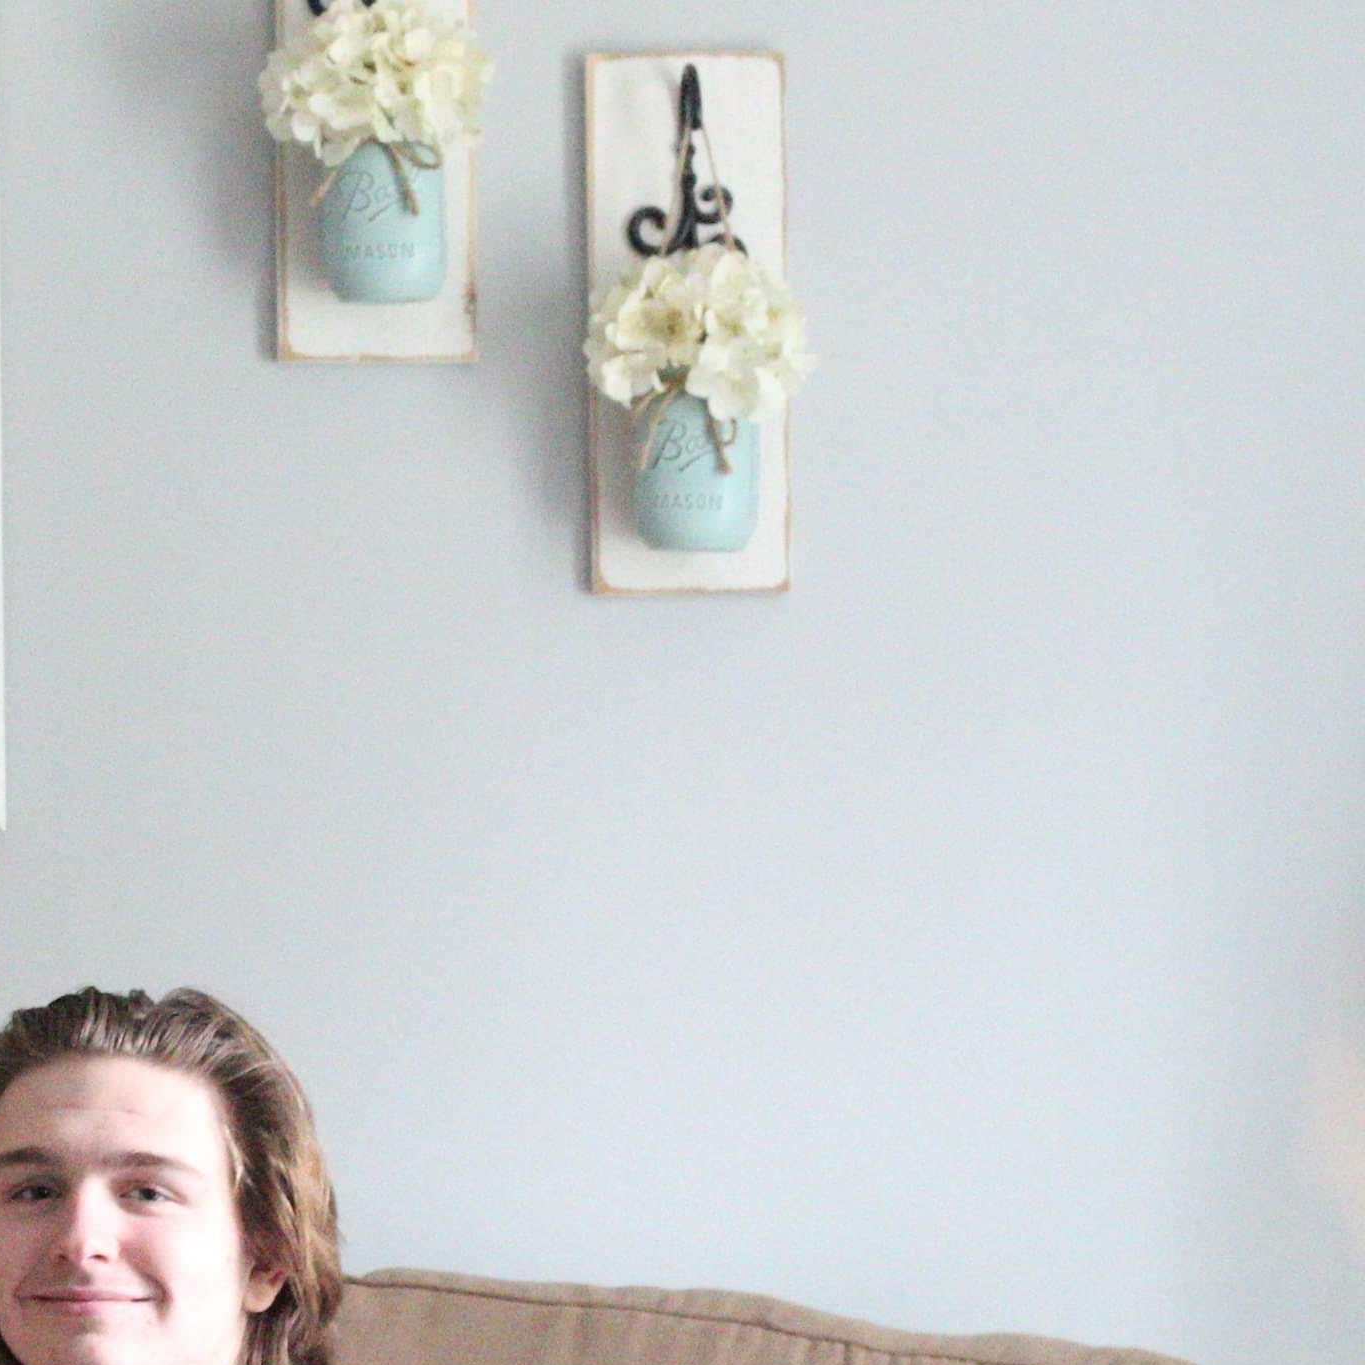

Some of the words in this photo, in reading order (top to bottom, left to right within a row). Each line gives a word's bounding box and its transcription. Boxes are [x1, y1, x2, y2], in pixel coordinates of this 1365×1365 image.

[337, 170, 399, 222] Ba
[342, 241, 415, 260] MASON
[652, 420, 717, 472] Ba
[652, 493, 724, 511] MASON
